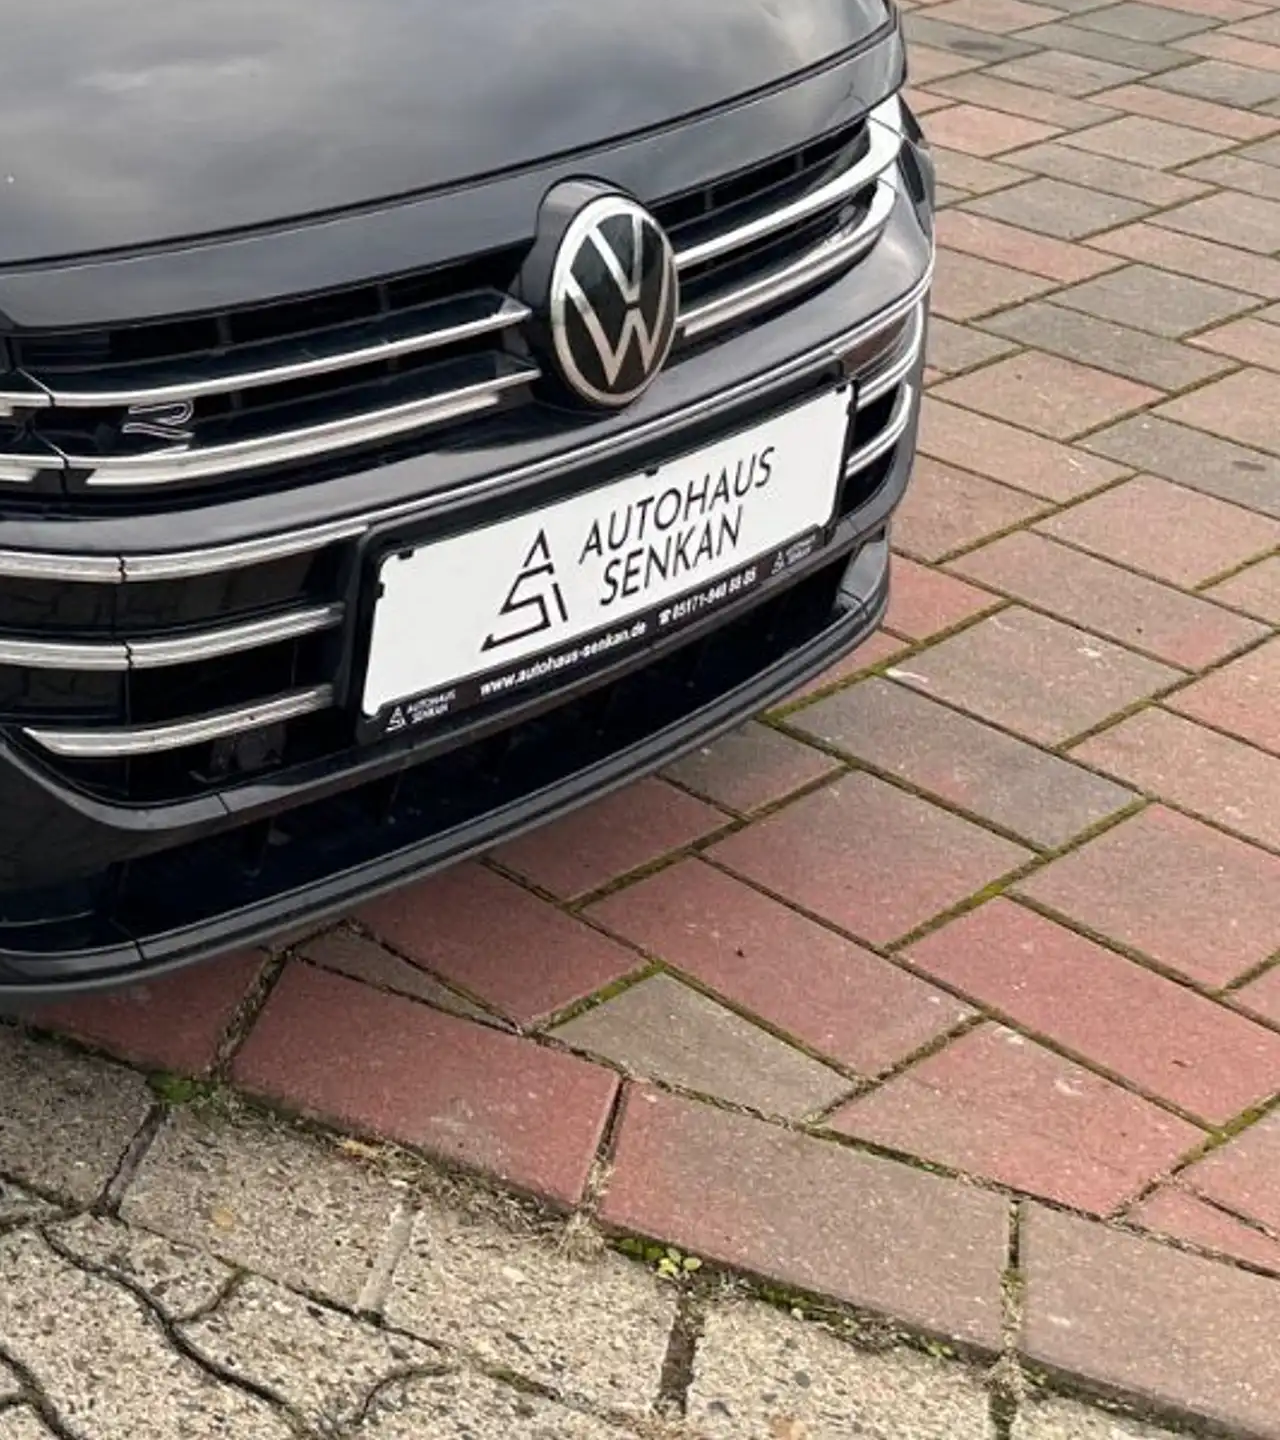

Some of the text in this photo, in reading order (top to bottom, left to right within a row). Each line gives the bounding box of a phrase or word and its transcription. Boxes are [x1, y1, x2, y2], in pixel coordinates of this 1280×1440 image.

[578, 446, 776, 565] AUTOHAUS
[599, 504, 744, 606] SENKAN
[479, 620, 648, 697] www.autohaus-senkan.de
